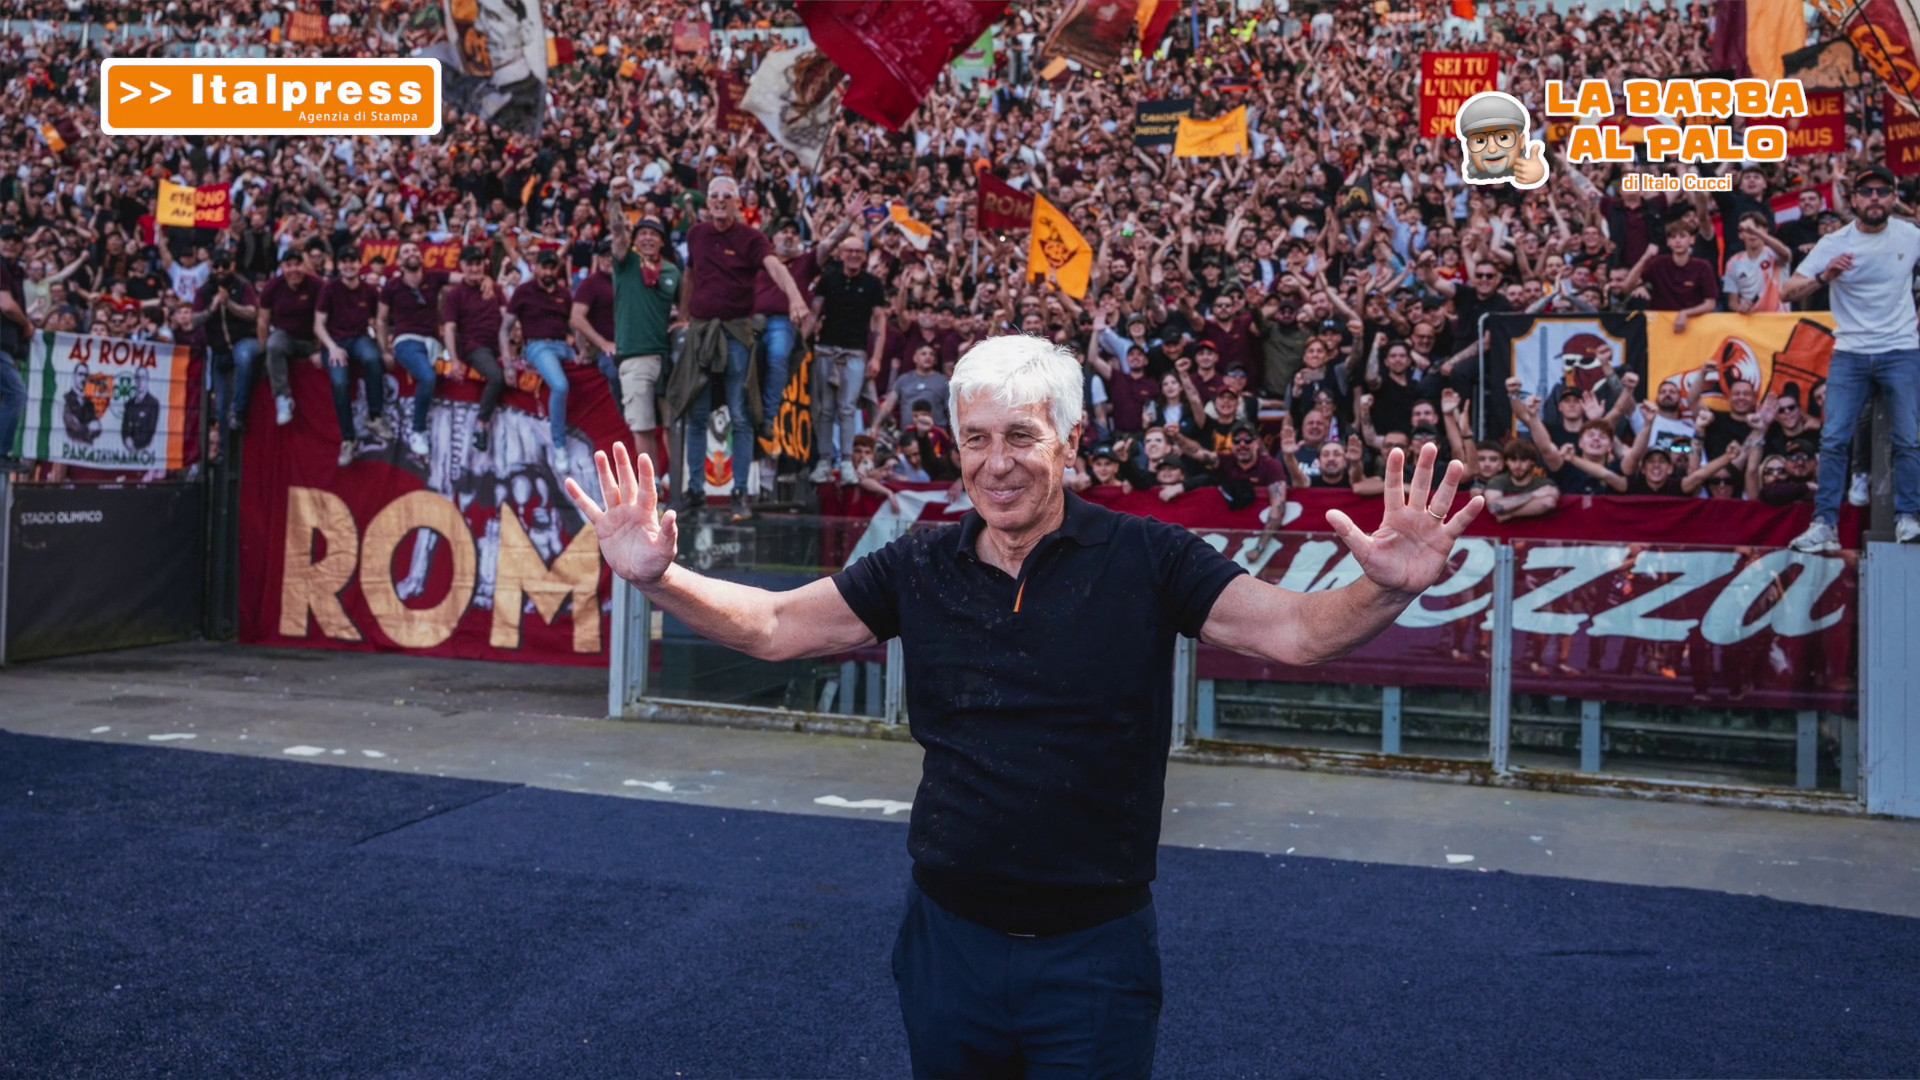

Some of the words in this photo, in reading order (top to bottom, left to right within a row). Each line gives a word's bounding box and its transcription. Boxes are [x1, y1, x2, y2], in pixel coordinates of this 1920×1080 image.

[1433, 57, 1461, 76] SEI
[1464, 57, 1490, 76] TU
[1424, 78, 1494, 97] L'UNICA
[1436, 99, 1460, 116] MI
[1430, 117, 1458, 136] SPO
[983, 191, 1031, 219] ROM
[69, 336, 94, 363] AS
[99, 339, 158, 369] ROMA
[20, 511, 55, 526] STADIO
[57, 509, 104, 524] OLIMPICO
[278, 485, 603, 654] ROM
